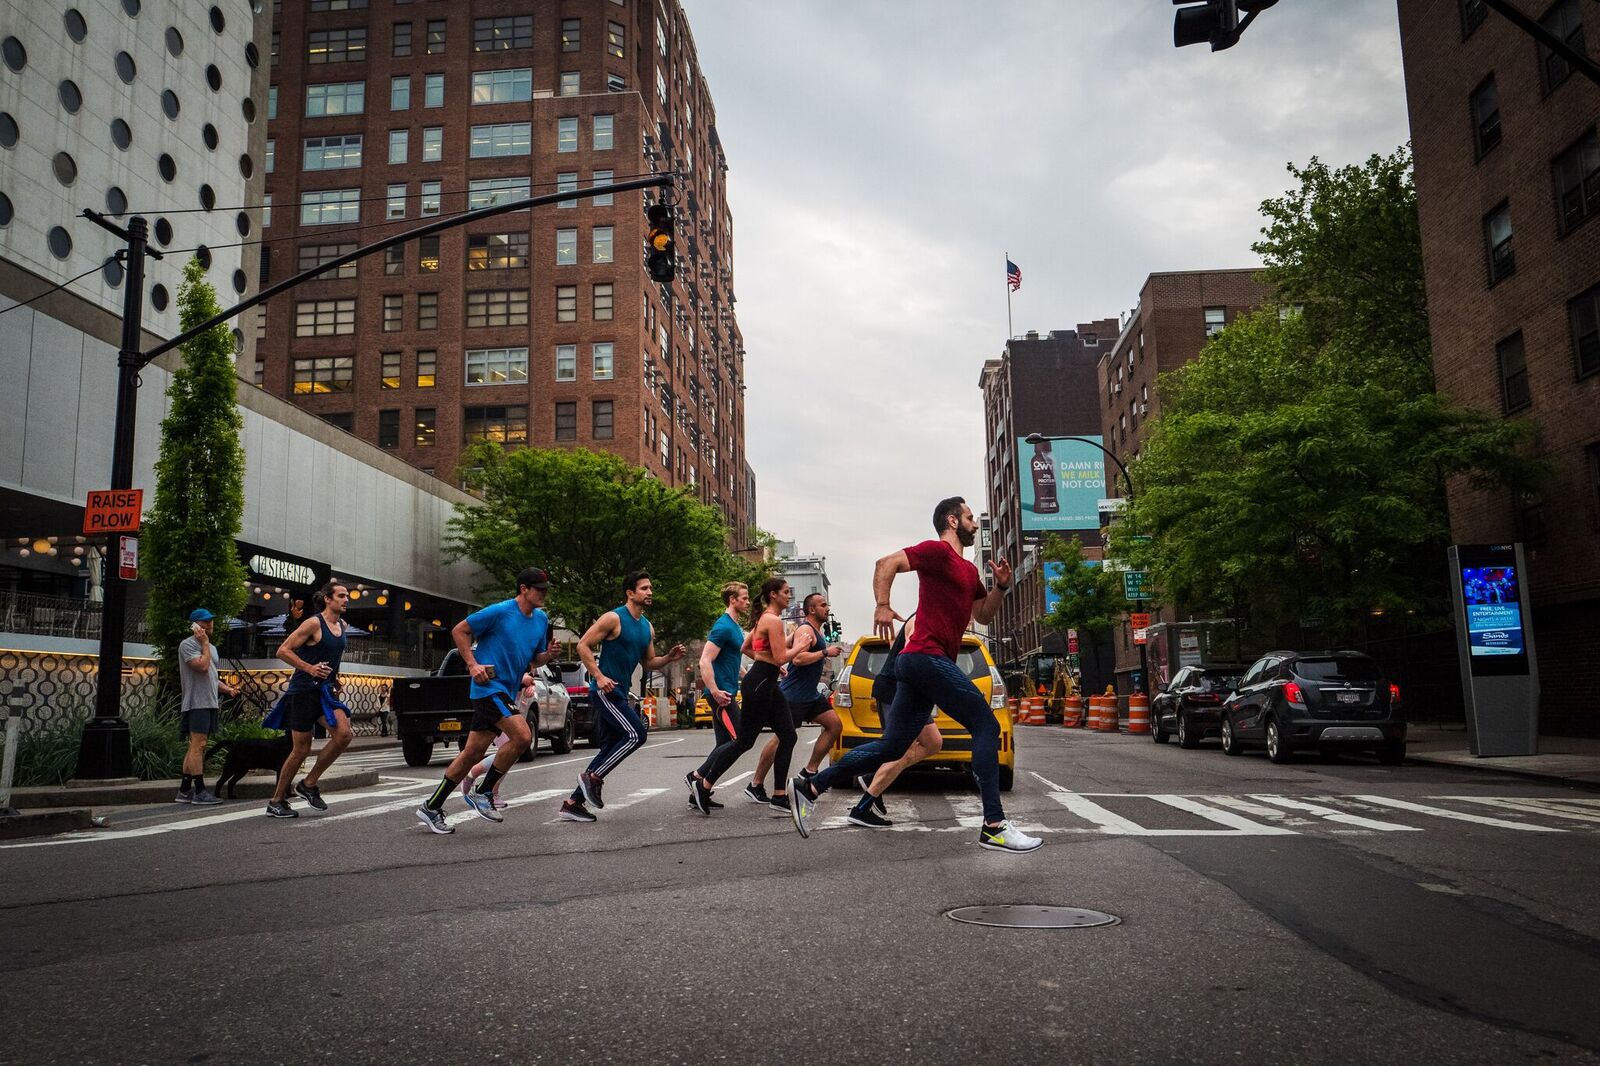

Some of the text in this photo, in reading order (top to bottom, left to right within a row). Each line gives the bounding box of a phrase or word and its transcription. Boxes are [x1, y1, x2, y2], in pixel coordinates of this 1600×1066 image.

[1061, 462, 1092, 471] DAMN
[1061, 470, 1100, 480] WE MILK
[1062, 480, 1082, 489] NOT
[92, 494, 136, 508] RAISE
[91, 513, 133, 528] PLOW
[1482, 632, 1509, 640] Sands
